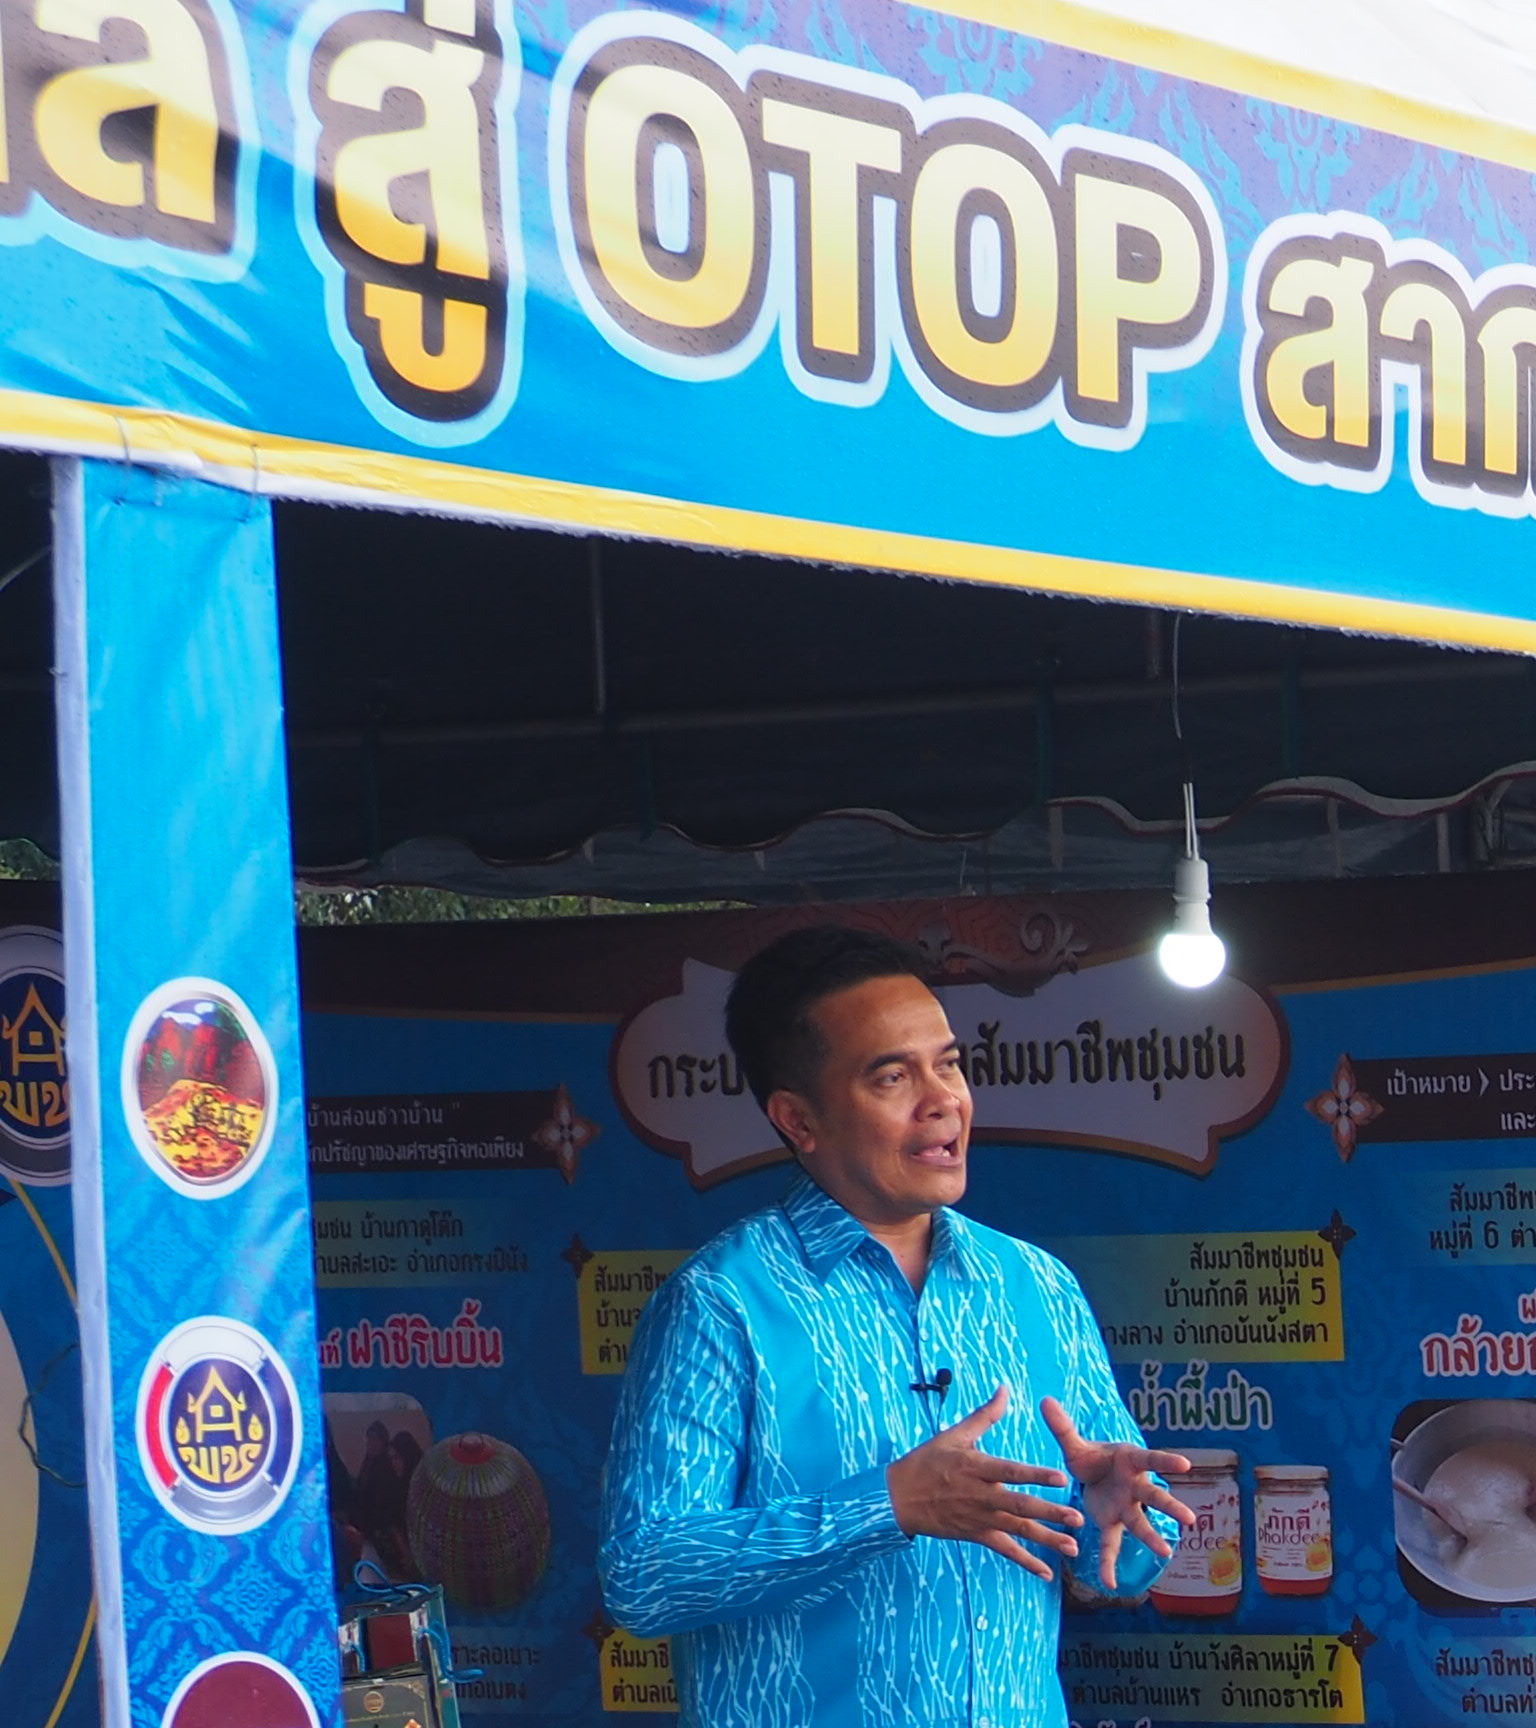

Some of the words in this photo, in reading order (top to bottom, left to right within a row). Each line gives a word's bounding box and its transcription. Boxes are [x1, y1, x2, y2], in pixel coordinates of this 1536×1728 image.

[583, 62, 1202, 404] OTOP
[1387, 1068, 1471, 1097] เป้าหมาย
[1429, 1219, 1473, 1259] หมู่ที่
[1483, 1219, 1499, 1250] 6
[1189, 1240, 1324, 1282] สัมมาชีพชุมชน
[1164, 1276, 1248, 1308] บ้านภักดี
[1258, 1271, 1301, 1315] หมู่ที่
[1311, 1277, 1327, 1306] 5
[1173, 1314, 1329, 1345] อำเภอบันนังสตา
[1131, 1362, 1270, 1428] น้ำผึ้งป่า
[1268, 1507, 1311, 1531] ภักดี
[1323, 1644, 1340, 1672] 7
[1222, 1679, 1344, 1709] อำเภอธารโต
